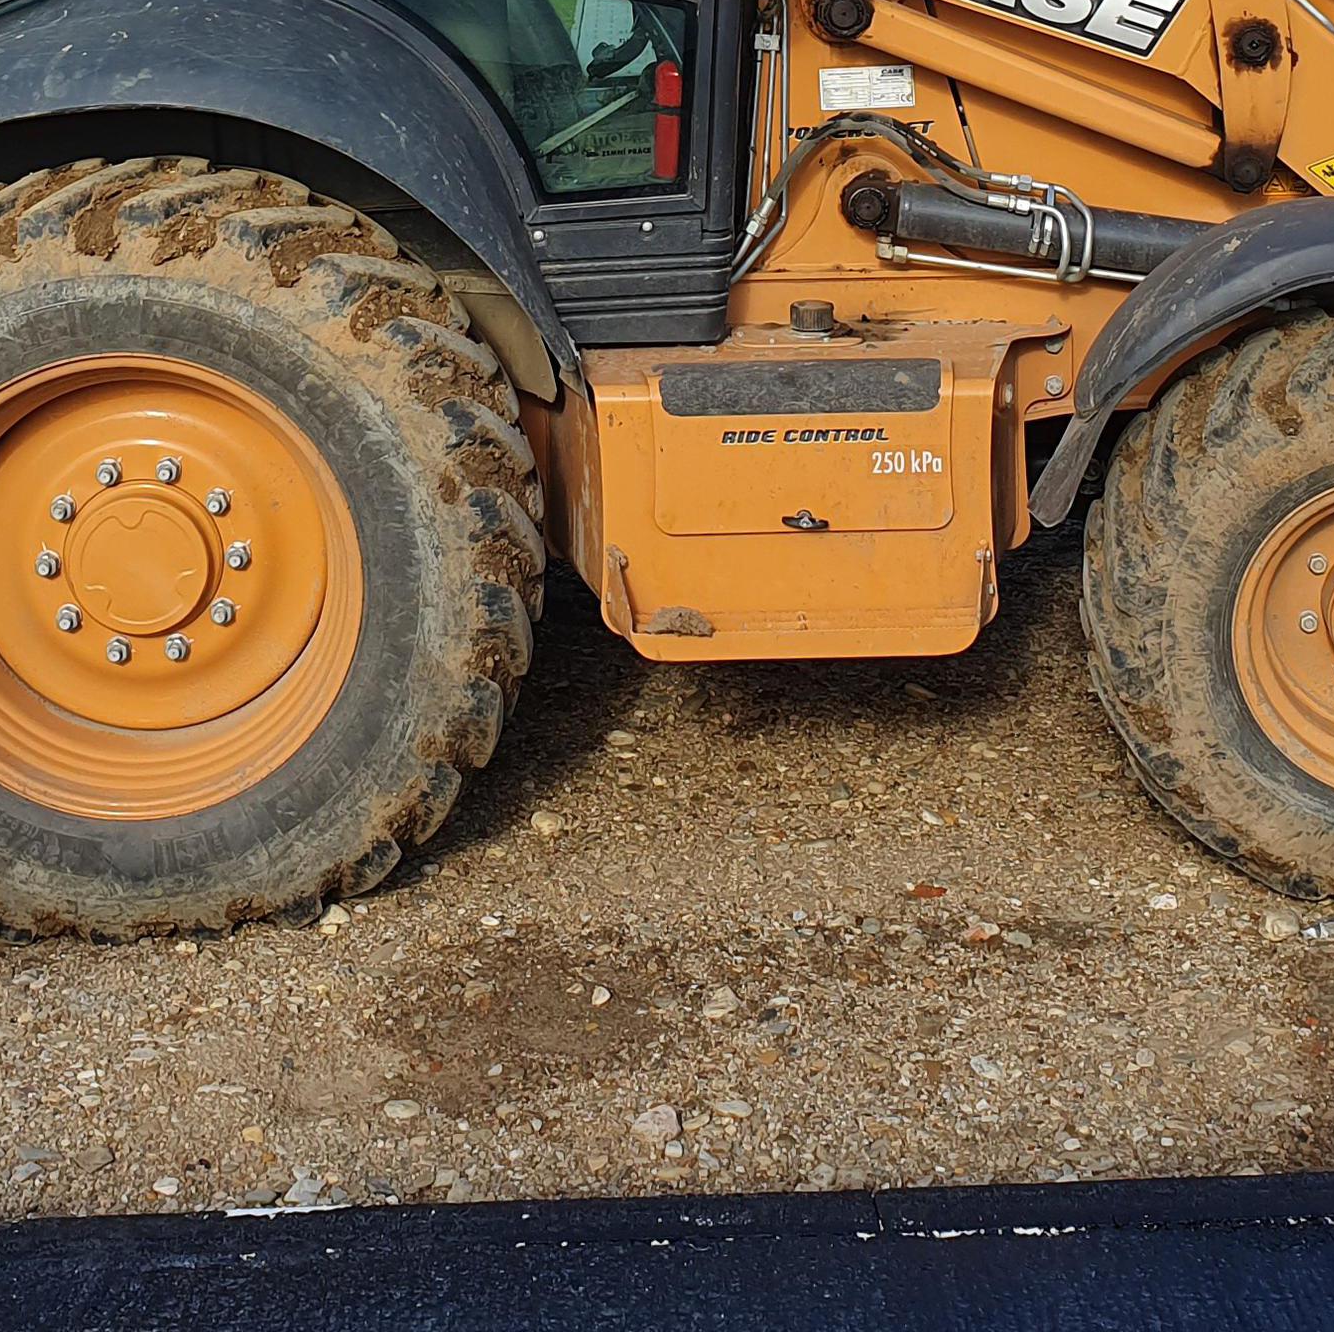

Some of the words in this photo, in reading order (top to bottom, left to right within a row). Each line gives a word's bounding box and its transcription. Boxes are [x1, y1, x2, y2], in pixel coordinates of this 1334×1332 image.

[721, 429, 778, 445] RIDE
[782, 427, 890, 444] CONTROL
[872, 451, 905, 474] 250
[910, 449, 943, 473] kPa
